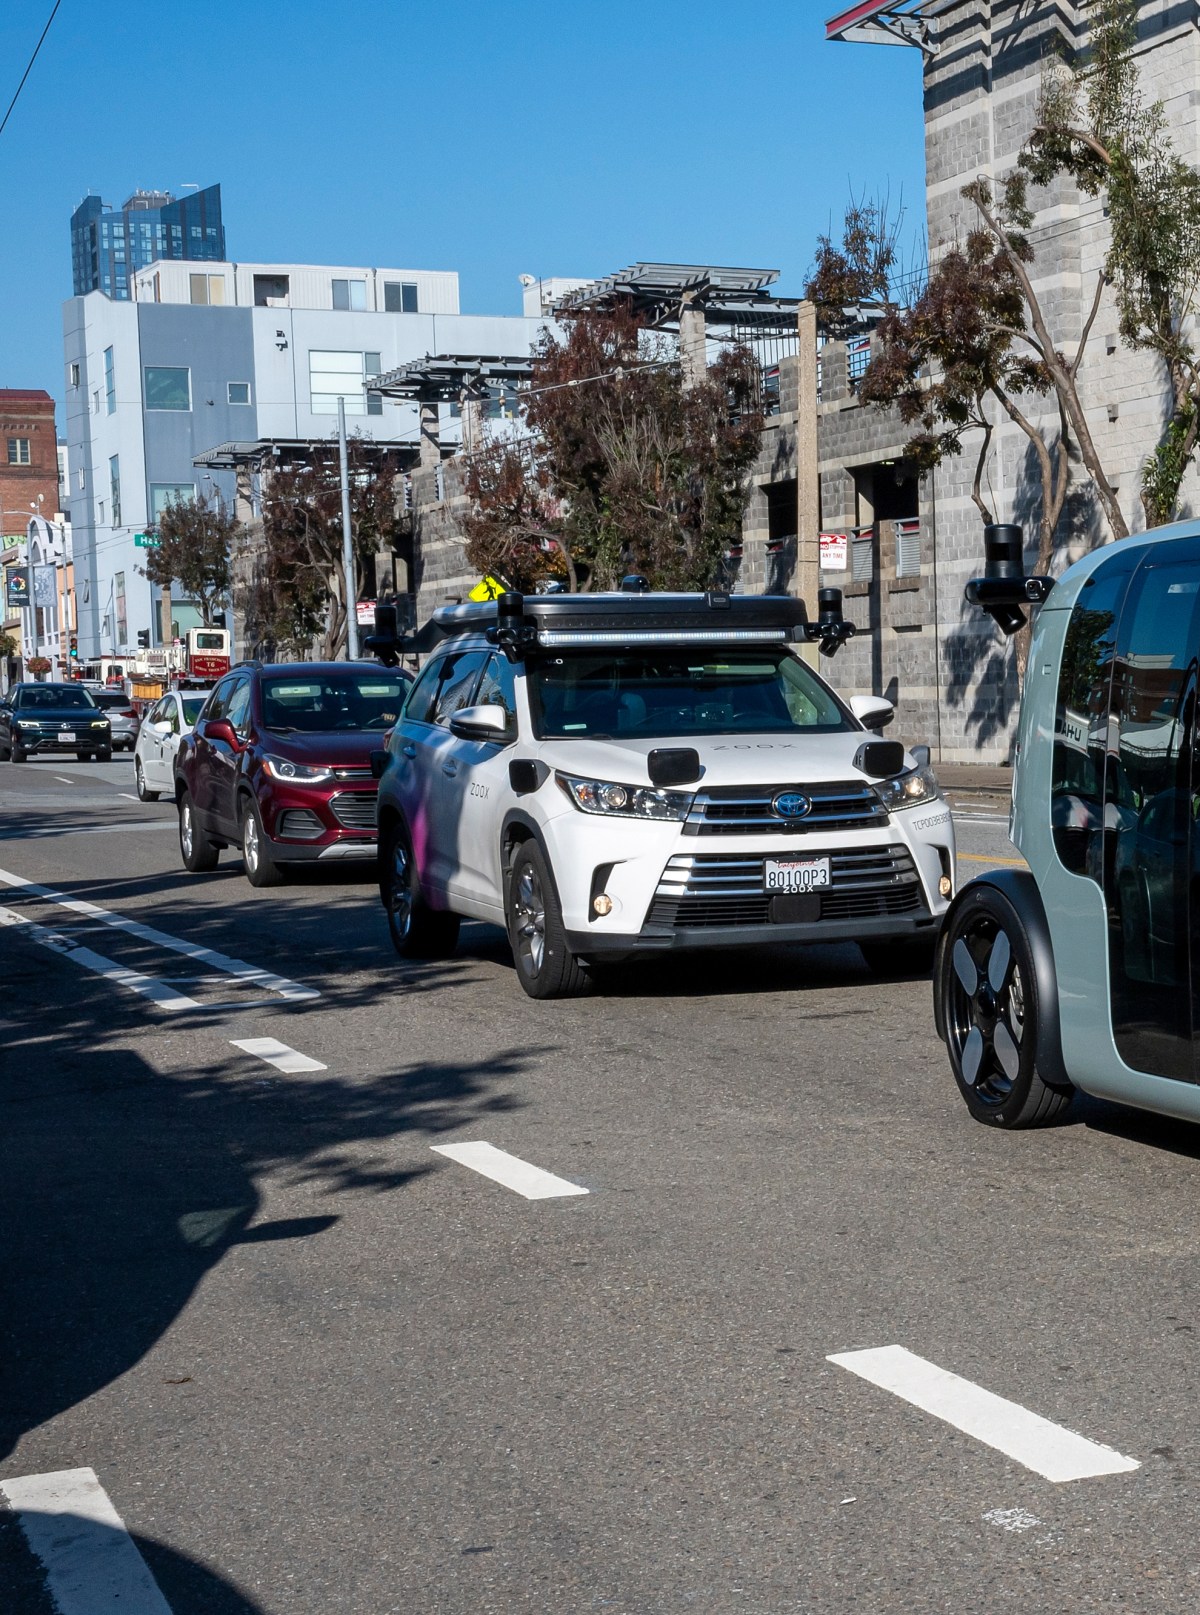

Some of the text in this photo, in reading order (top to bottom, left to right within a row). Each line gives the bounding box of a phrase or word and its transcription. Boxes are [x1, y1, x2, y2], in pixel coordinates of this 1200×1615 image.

[710, 743, 798, 751] ZOOX
[470, 782, 490, 799] ZOOX
[768, 868, 827, 888] 80100P3
[782, 885, 814, 894] ZOOX
